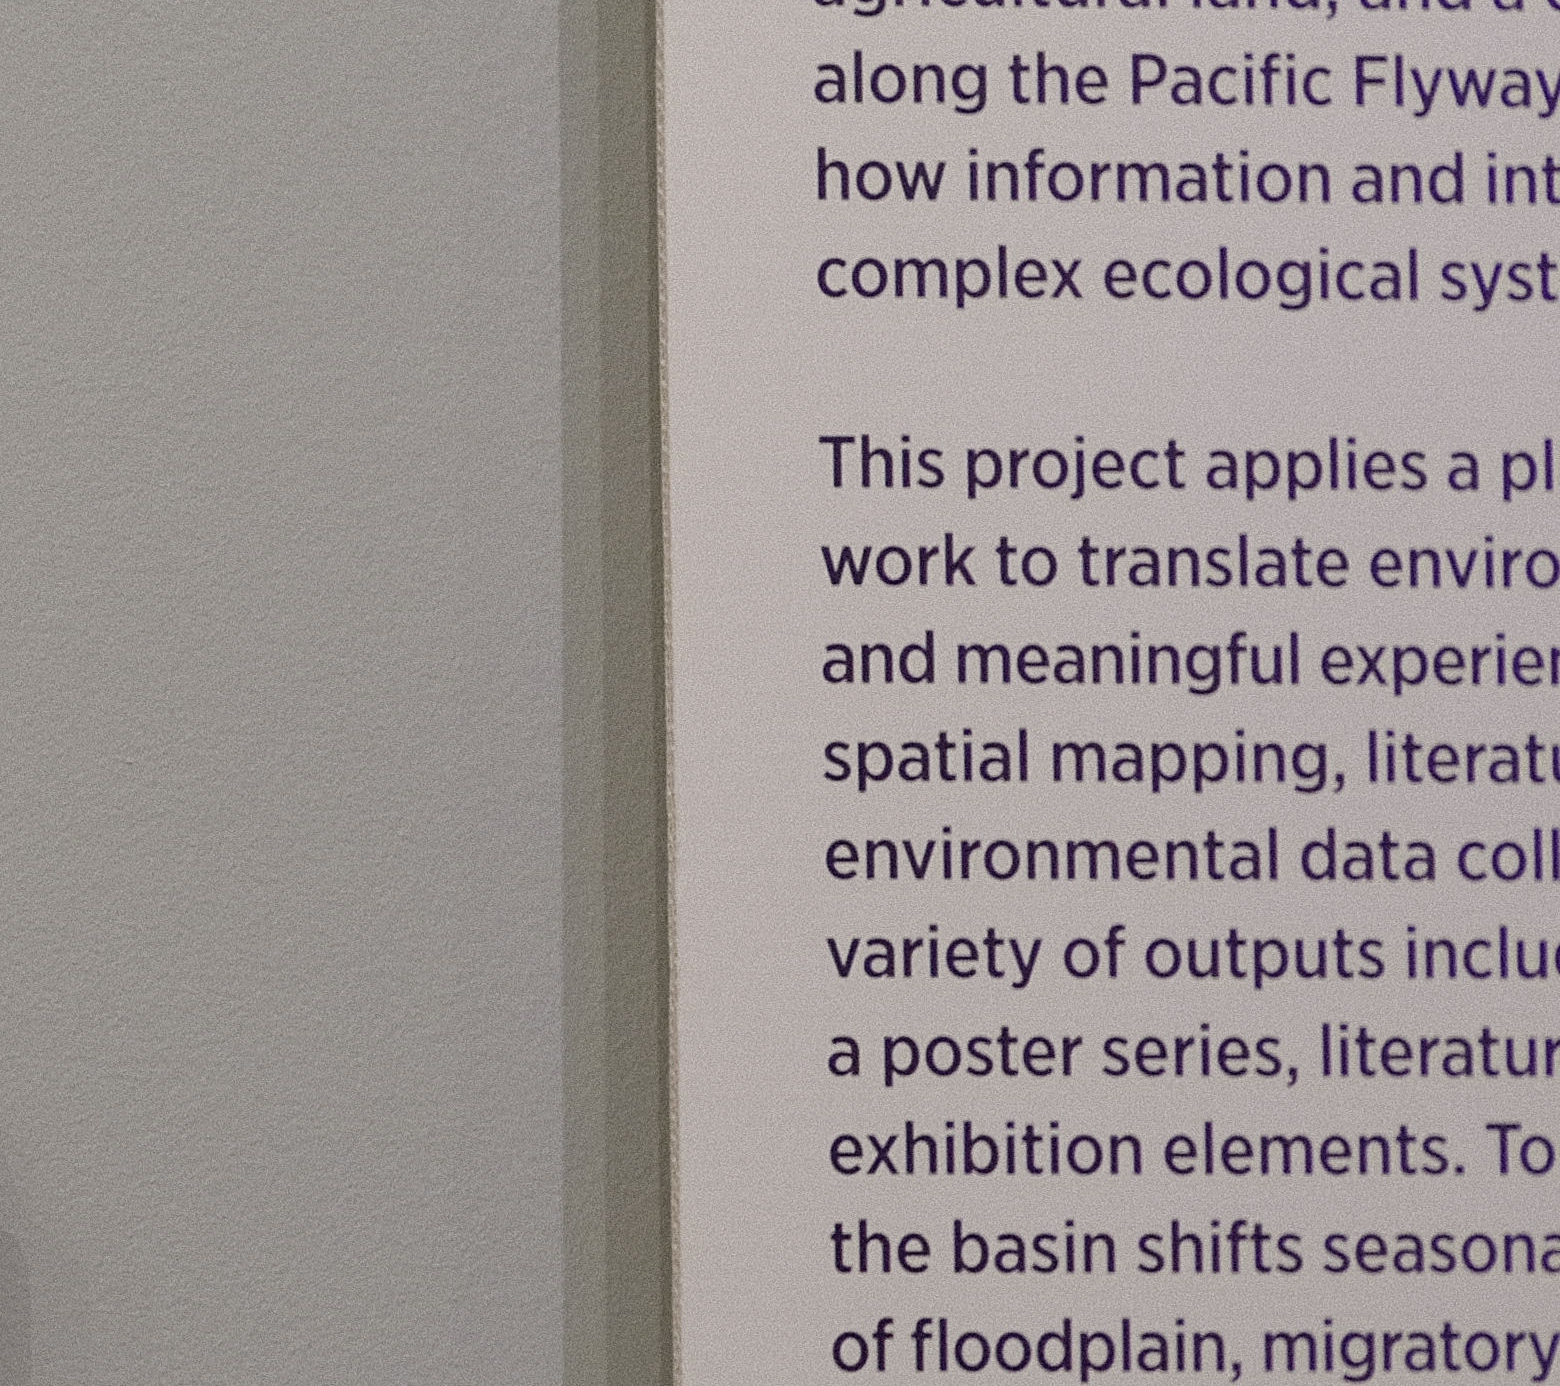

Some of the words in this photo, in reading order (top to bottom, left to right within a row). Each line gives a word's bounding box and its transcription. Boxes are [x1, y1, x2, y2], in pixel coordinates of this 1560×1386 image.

[814, 50, 986, 115] along
[1009, 51, 1108, 105] the
[1132, 52, 1331, 106] Pacific
[1355, 54, 1560, 119] Flyway
